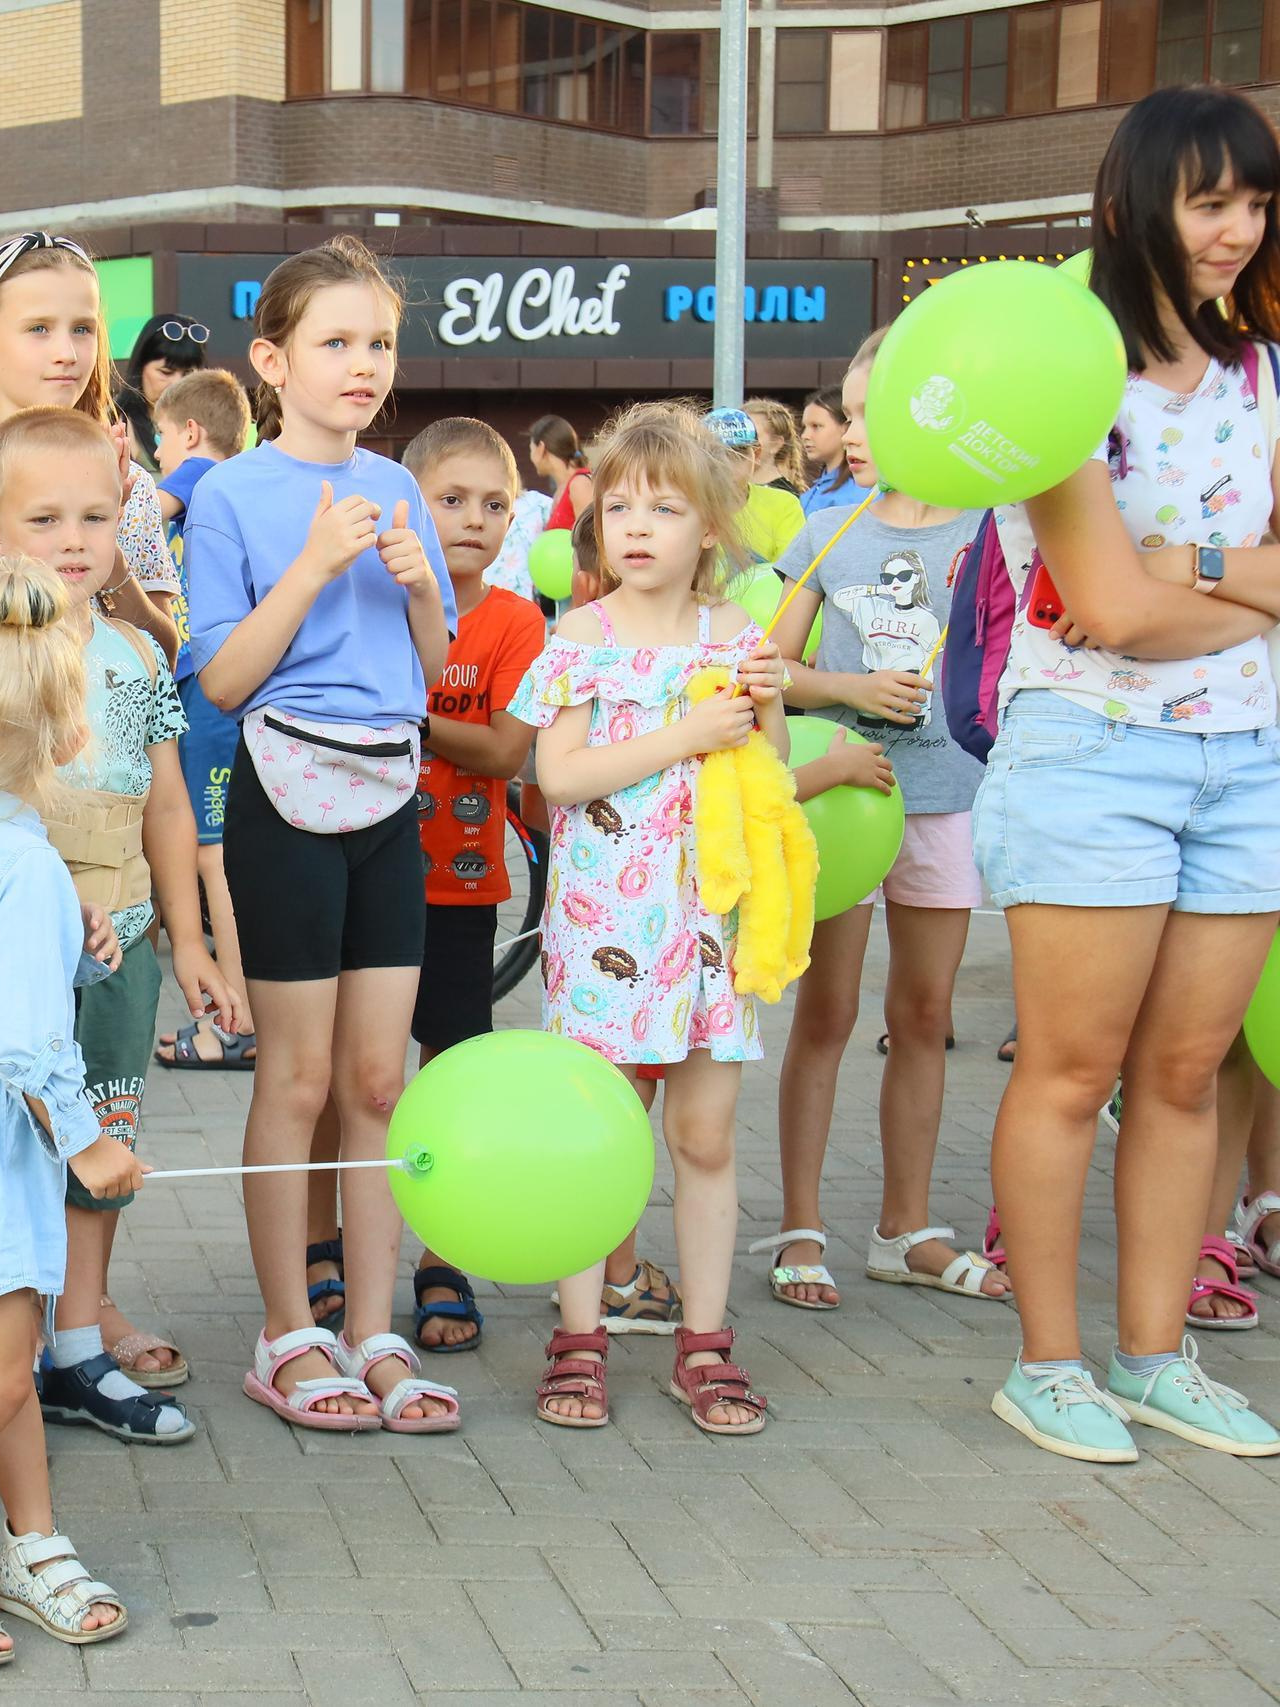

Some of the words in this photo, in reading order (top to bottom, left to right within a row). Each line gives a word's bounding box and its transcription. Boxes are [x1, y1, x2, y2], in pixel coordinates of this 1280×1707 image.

[438, 272, 504, 346] El
[506, 263, 631, 341] Chef
[871, 617, 921, 637] GIRL
[441, 664, 479, 689] YOUR
[464, 825, 481, 836] HAPPY
[464, 881, 478, 891] COOL
